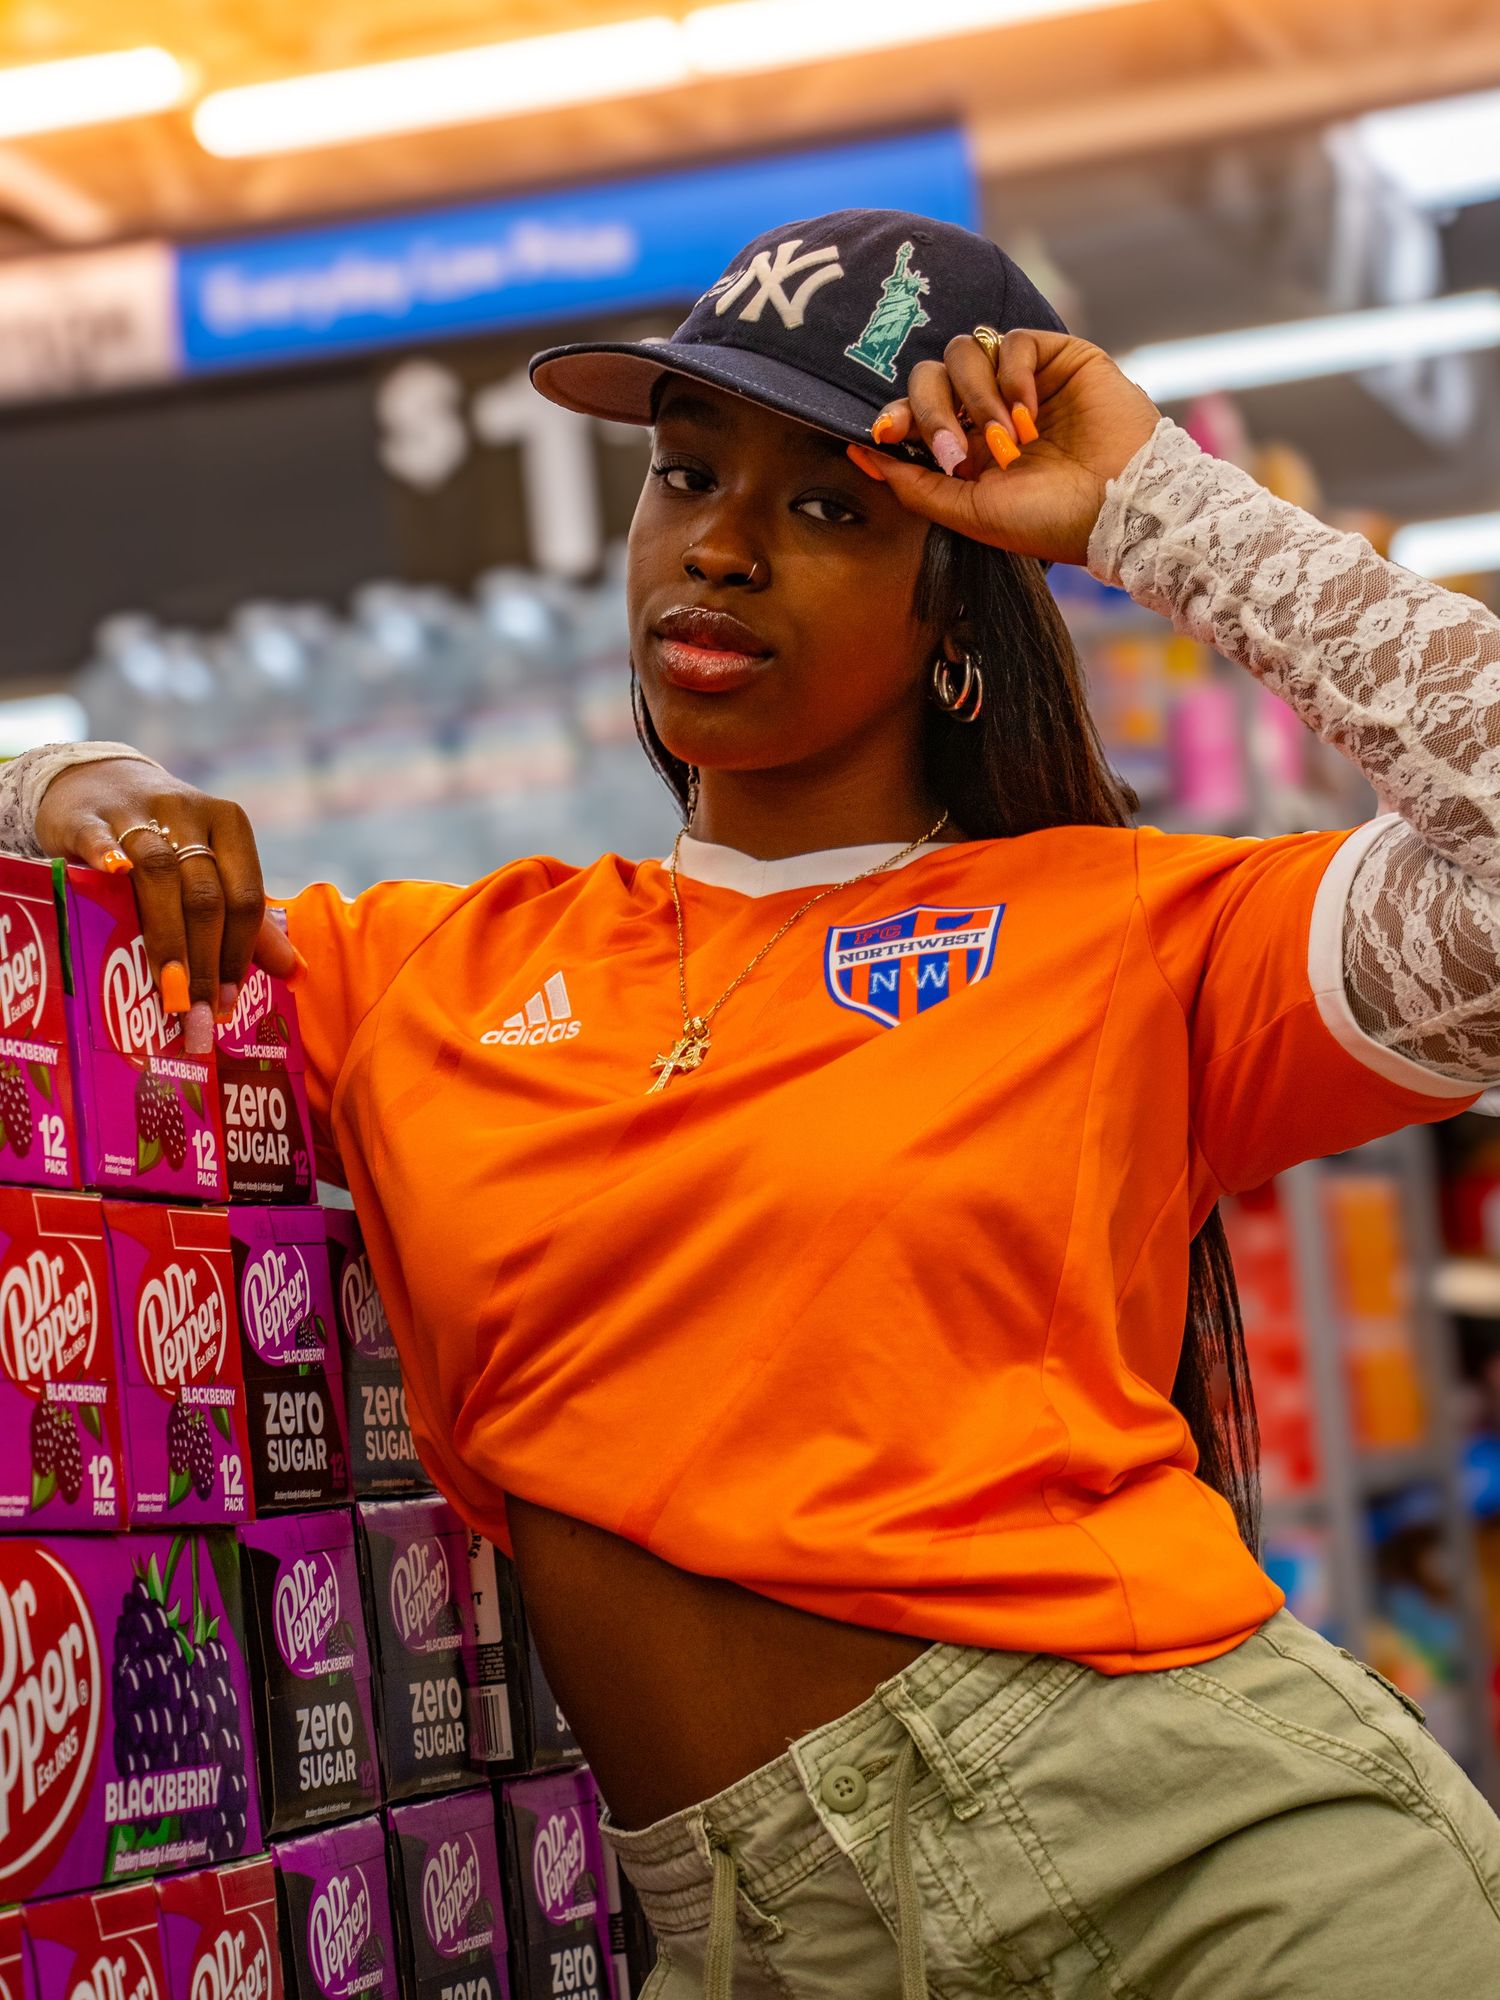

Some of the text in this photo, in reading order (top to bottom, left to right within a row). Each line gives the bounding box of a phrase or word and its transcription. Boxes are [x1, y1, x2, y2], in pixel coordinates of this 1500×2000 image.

[131, 934, 153, 1001] D
[838, 931, 985, 965] NORTHWEST
[0, 1038, 58, 1066] LACKBERRY
[243, 1044, 288, 1060] BLACKBERRY
[480, 1020, 582, 1046] adidas
[150, 1057, 209, 1083] BLACKBERRY
[223, 1083, 287, 1130] zero
[38, 1114, 67, 1158] 12
[192, 1129, 218, 1172] 12
[226, 1129, 291, 1166] SUGAR
[44, 1159, 68, 1176] PACK
[197, 1171, 218, 1188] PACK
[27, 1250, 64, 1322] Dr
[163, 1263, 197, 1331] Dr
[262, 1249, 287, 1301] Dr
[0, 1265, 89, 1381] Pepper
[244, 1262, 304, 1350] Pepper
[138, 1278, 220, 1386] Pepper
[283, 1348, 326, 1364] BLACKBERRY
[45, 1383, 108, 1404] BLACKBERRY
[180, 1386, 236, 1406] BLACKBERRY
[263, 1391, 325, 1436] zero
[88, 1455, 116, 1499] 12
[219, 1454, 244, 1495] 12
[267, 1437, 328, 1473] SUGAR
[93, 1500, 116, 1516] PACK
[224, 1497, 244, 1512] PACK
[292, 1559, 317, 1613] Dr
[407, 1543, 429, 1591] Dr
[276, 1574, 333, 1665] Pepper
[391, 1556, 444, 1642] Pepper
[313, 1653, 354, 1676] BLACKBERRY
[425, 1634, 463, 1653] BLACKBERRY
[409, 1677, 463, 1724] zero
[295, 1701, 354, 1753] zero
[413, 1721, 467, 1761] SUGAR
[299, 1748, 358, 1792] SUGAR
[105, 1766, 222, 1823] BLACKBERRY
[548, 1814, 568, 1863] Dr
[439, 1841, 460, 1890] Dr
[534, 1828, 580, 1913] Pepper
[327, 1876, 350, 1933] Dr
[424, 1855, 475, 1946] Pepper
[214, 1930, 246, 1995] Dr
[310, 1894, 365, 1989] Pepper
[457, 1930, 494, 1954] BLACKBERRY
[346, 1968, 384, 1996] BLACKBERRY
[551, 1943, 598, 1994] zero
